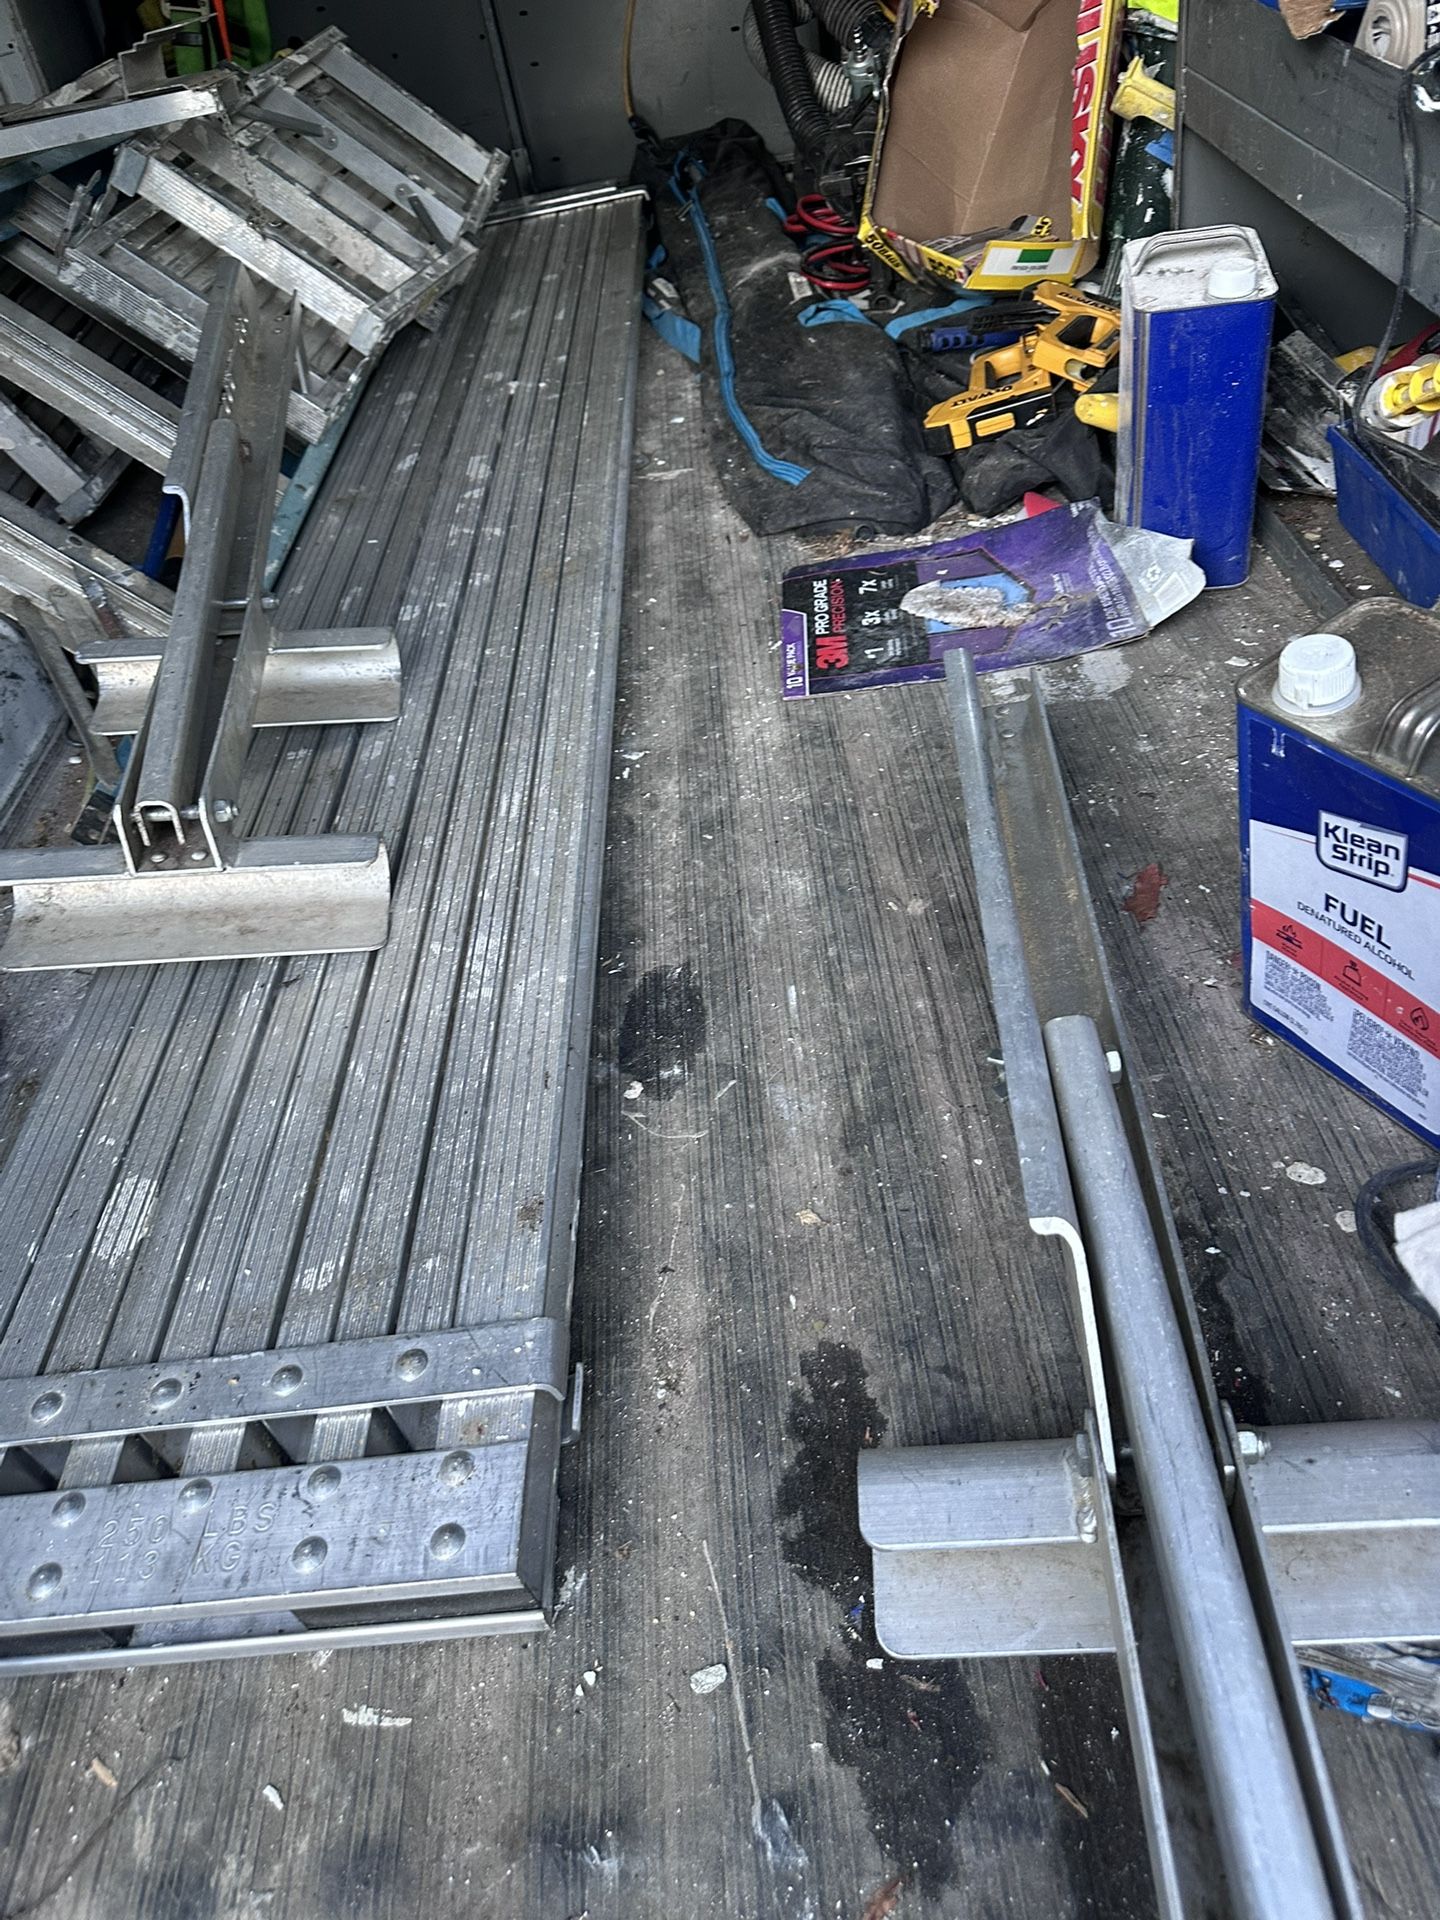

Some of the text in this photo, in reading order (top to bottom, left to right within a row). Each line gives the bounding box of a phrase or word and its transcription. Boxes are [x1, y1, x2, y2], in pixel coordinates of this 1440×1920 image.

[865, 233, 882, 251] 50
[813, 579, 830, 635] PRO GRADE
[830, 580, 846, 633] PRECISION
[1105, 617, 1137, 638] 10
[815, 635, 849, 669] 3M
[786, 676, 804, 689] 10
[1324, 822, 1400, 861] Klean
[1331, 844, 1391, 877] Strip
[1297, 901, 1416, 981] DENATURED ALCOHOL
[1324, 893, 1391, 950] FUEL
[99, 1503, 276, 1548] 250 LBS
[90, 1540, 242, 1584] 113 KG
